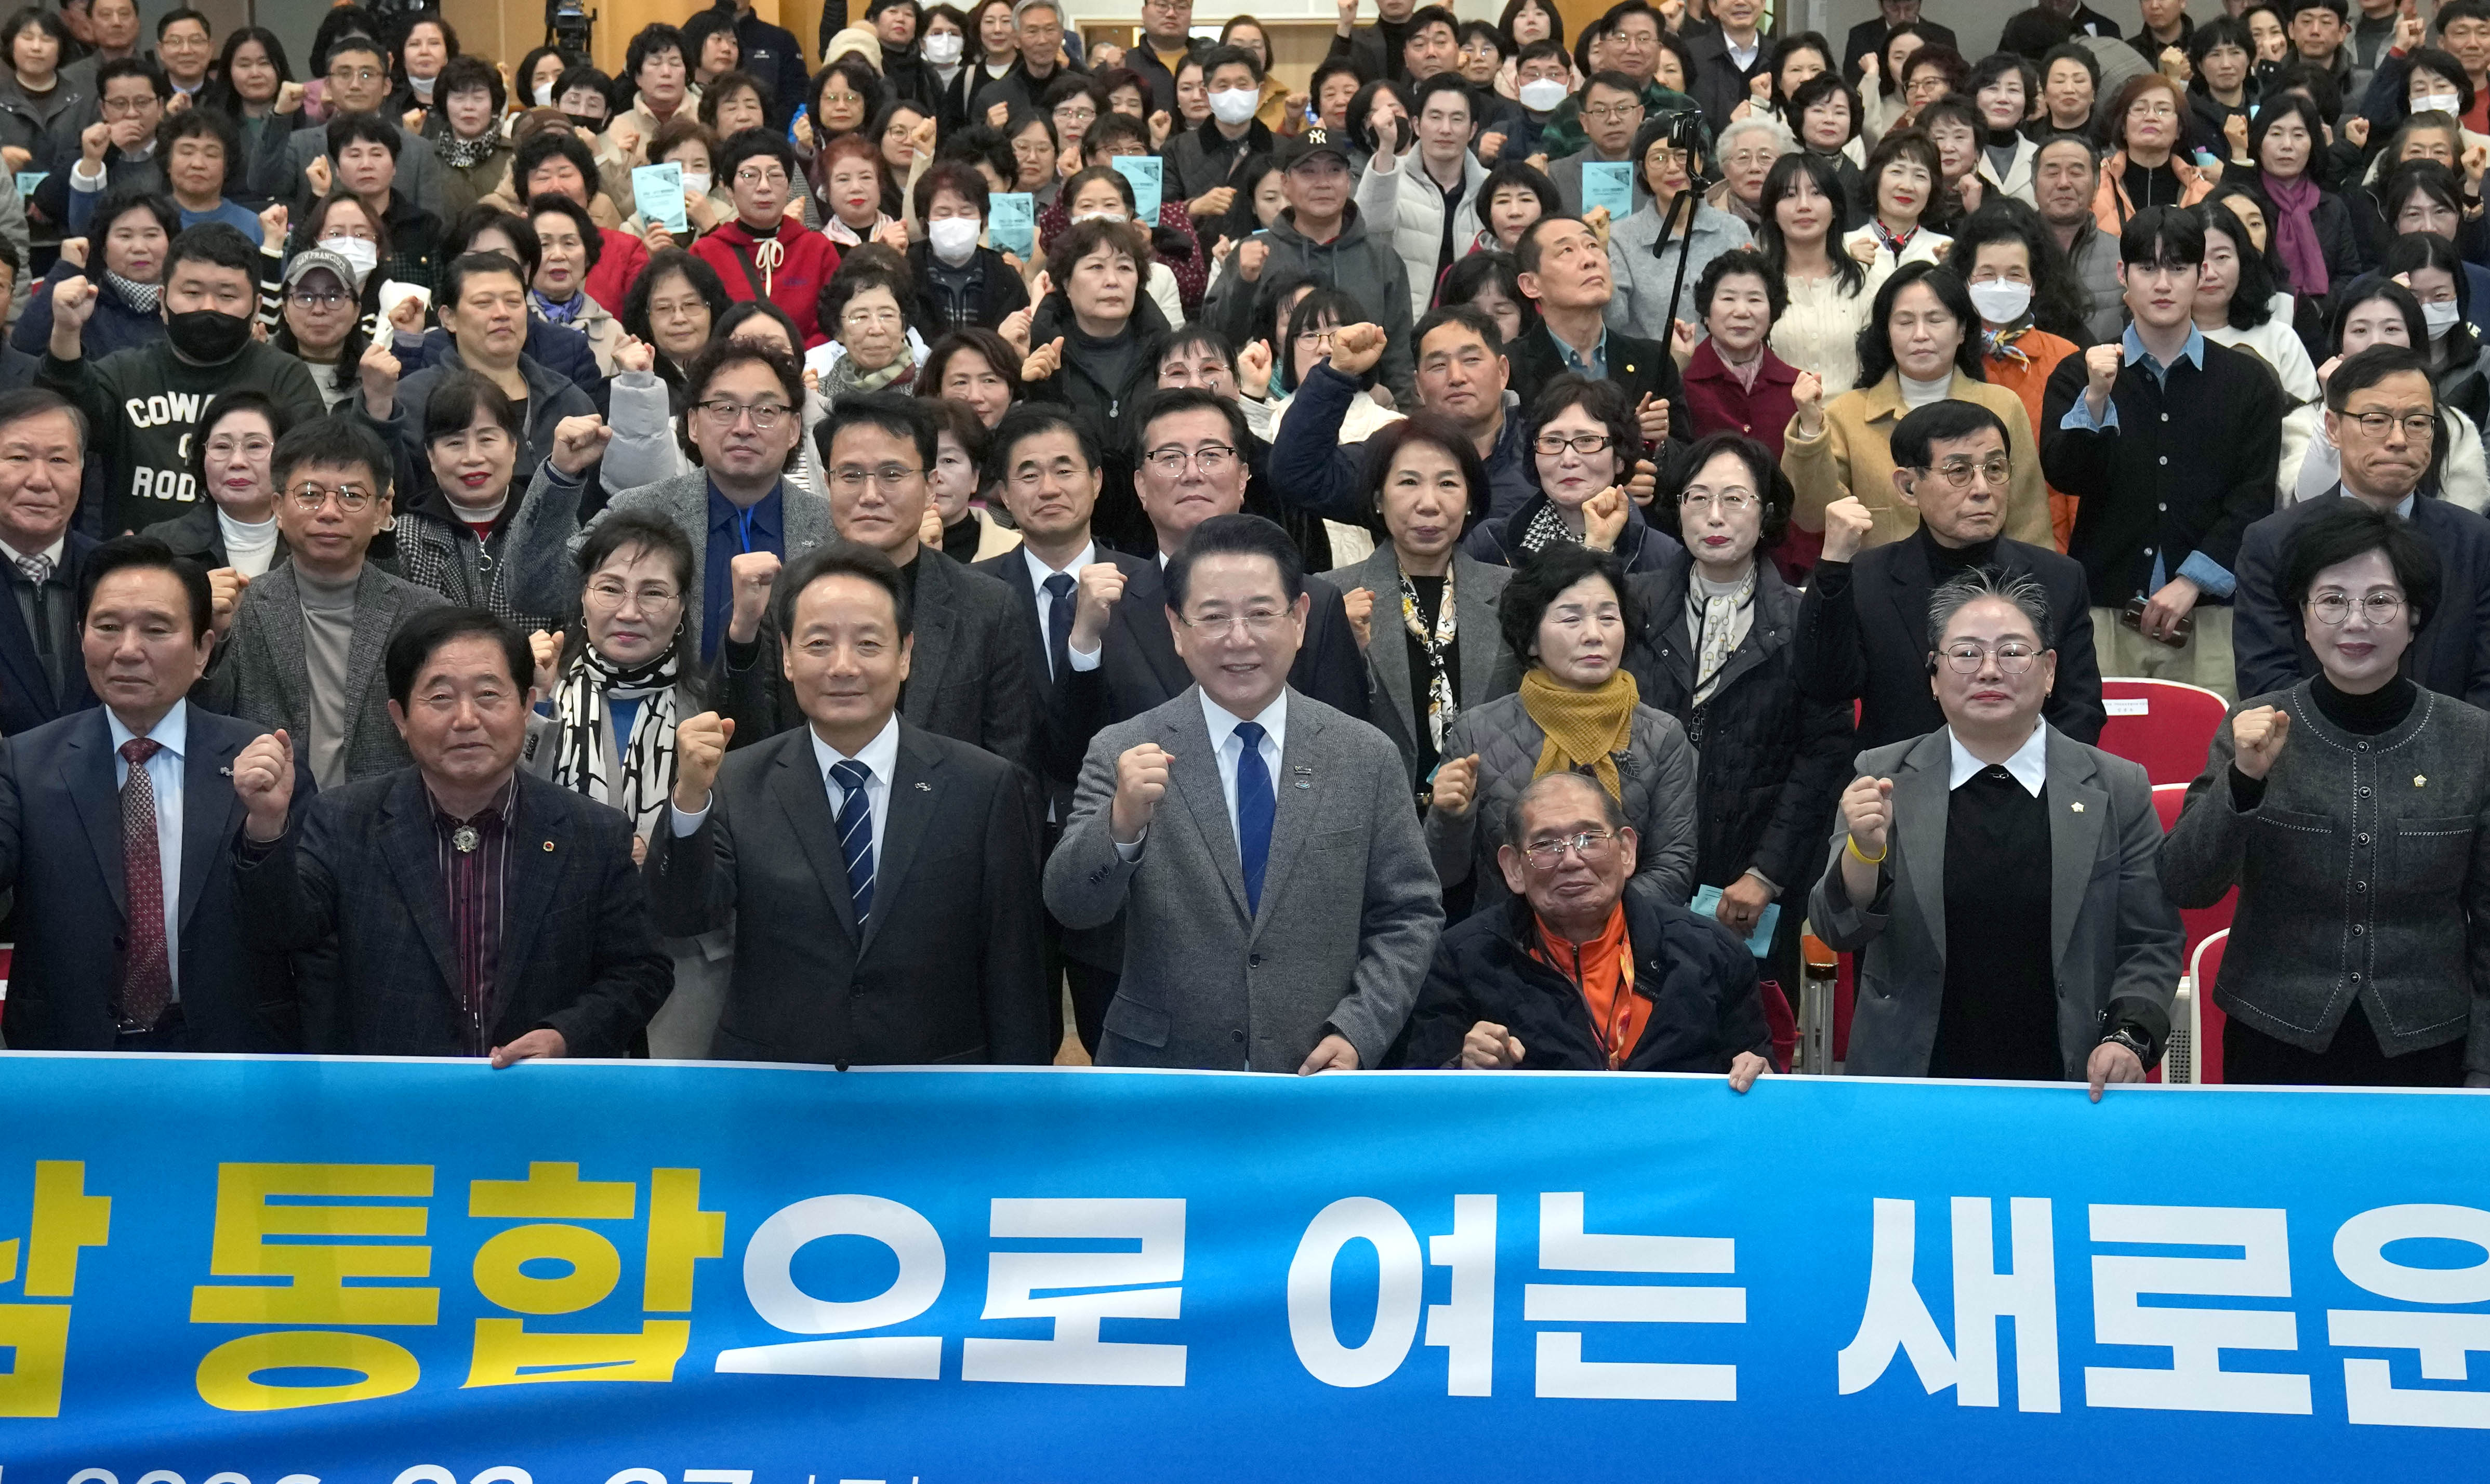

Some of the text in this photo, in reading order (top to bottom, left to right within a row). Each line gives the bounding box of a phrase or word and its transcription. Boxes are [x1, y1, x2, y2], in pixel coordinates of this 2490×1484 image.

[1308, 130, 1326, 144] NY
[296, 251, 346, 273] SAN FRANCISCO
[190, 1161, 1187, 1411] 통합으로
[1288, 1192, 1746, 1401] 여는
[1838, 1197, 2490, 1429] 새로운
